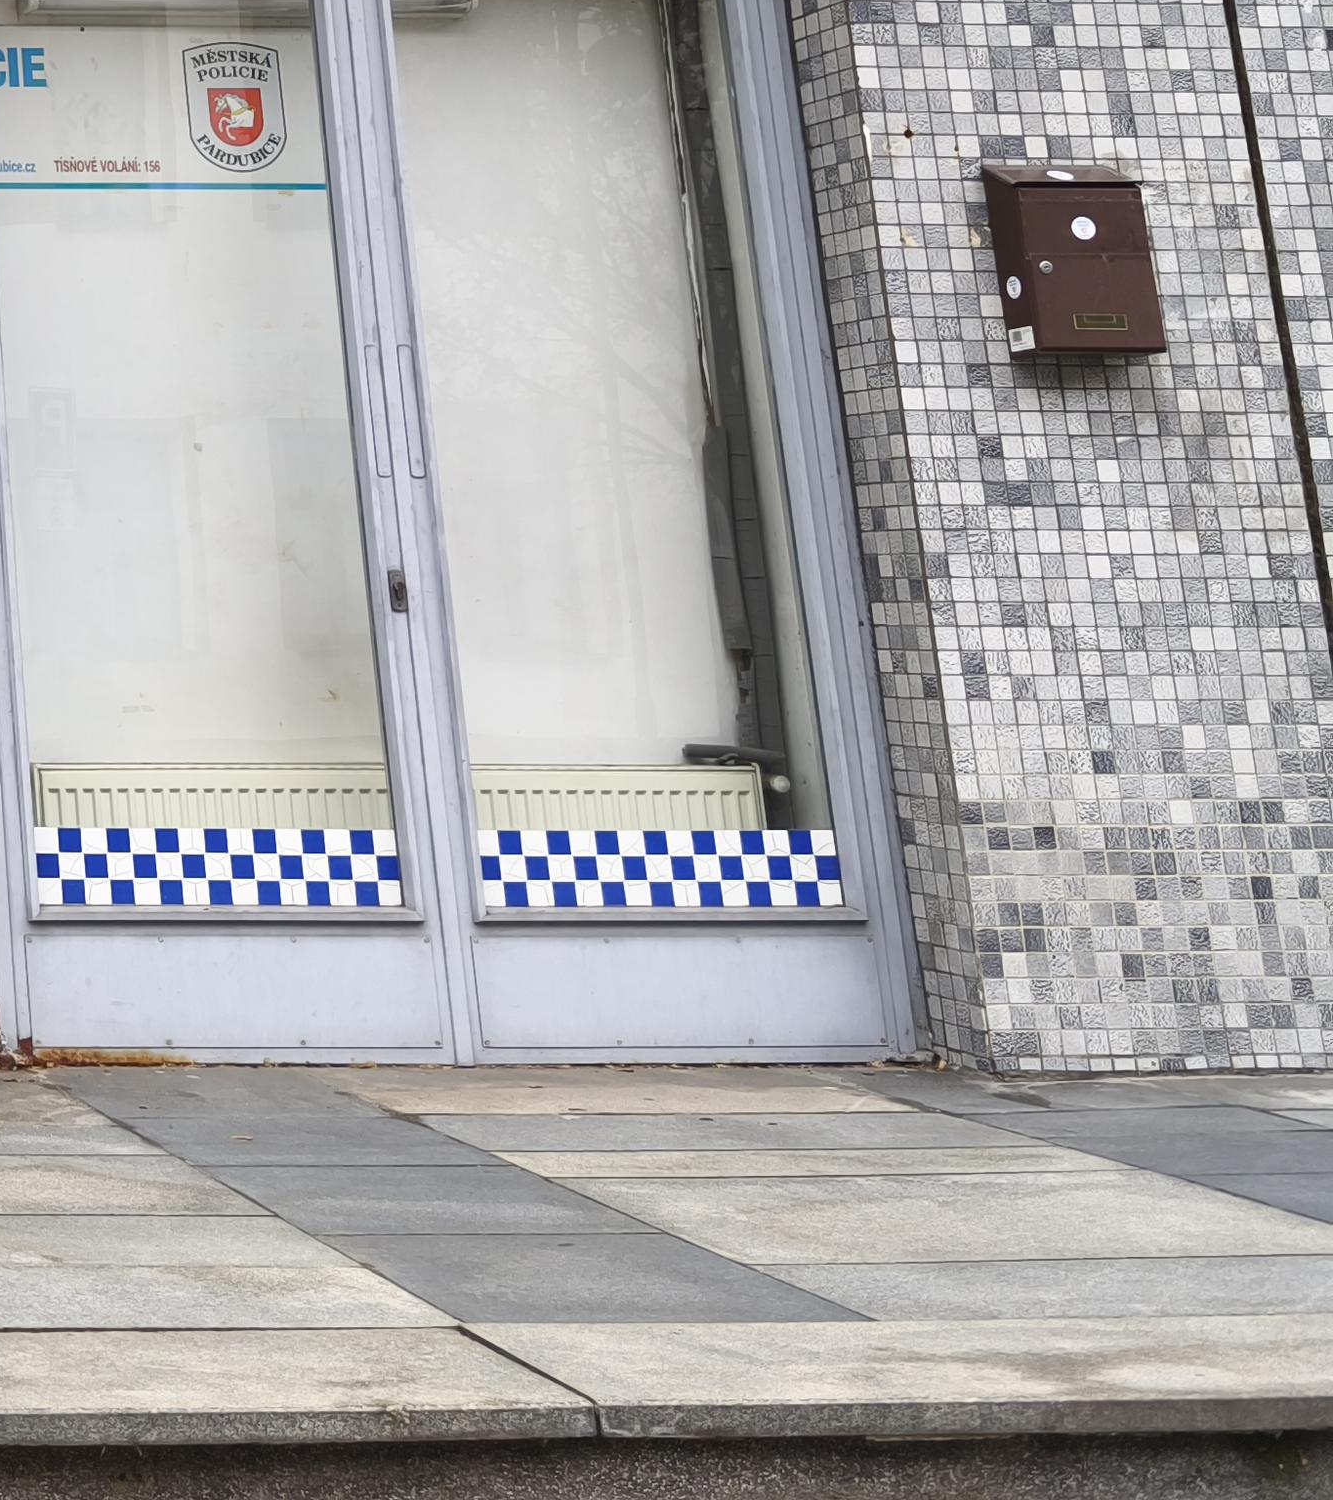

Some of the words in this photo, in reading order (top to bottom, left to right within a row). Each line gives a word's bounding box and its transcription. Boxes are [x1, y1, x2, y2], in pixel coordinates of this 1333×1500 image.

[190, 48, 272, 69] MĚSTSKÁ
[197, 66, 269, 82] POLICIE
[197, 133, 282, 167] PARDUBICE
[53, 156, 99, 173] TÍSŇOVÉ
[100, 156, 141, 173] VOLÁNÍ:
[143, 160, 161, 173] 156
